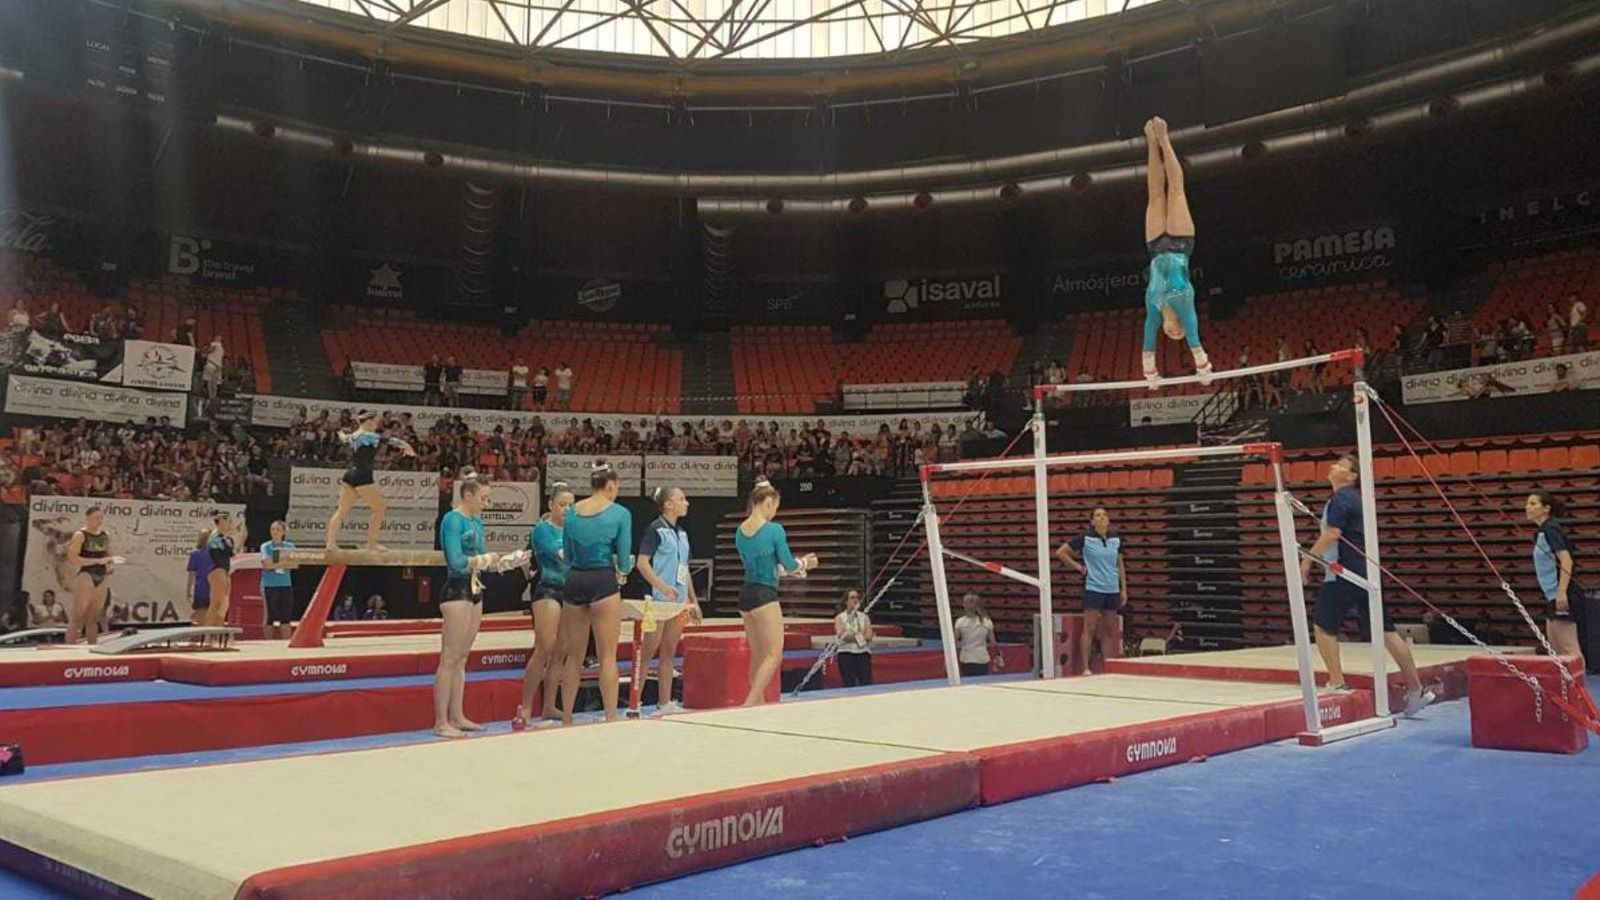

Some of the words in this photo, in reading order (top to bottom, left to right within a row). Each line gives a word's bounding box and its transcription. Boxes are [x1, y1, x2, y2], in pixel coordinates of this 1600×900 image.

[1273, 227, 1395, 264] PAMESA
[920, 275, 1000, 302] isaval
[32, 499, 79, 514] divina
[139, 502, 182, 518] divina
[64, 665, 129, 679] GYMNOVA
[291, 664, 347, 676] GYMNOVA
[1126, 736, 1177, 763] GYMNOVA
[666, 805, 784, 859] GYMNOVA
